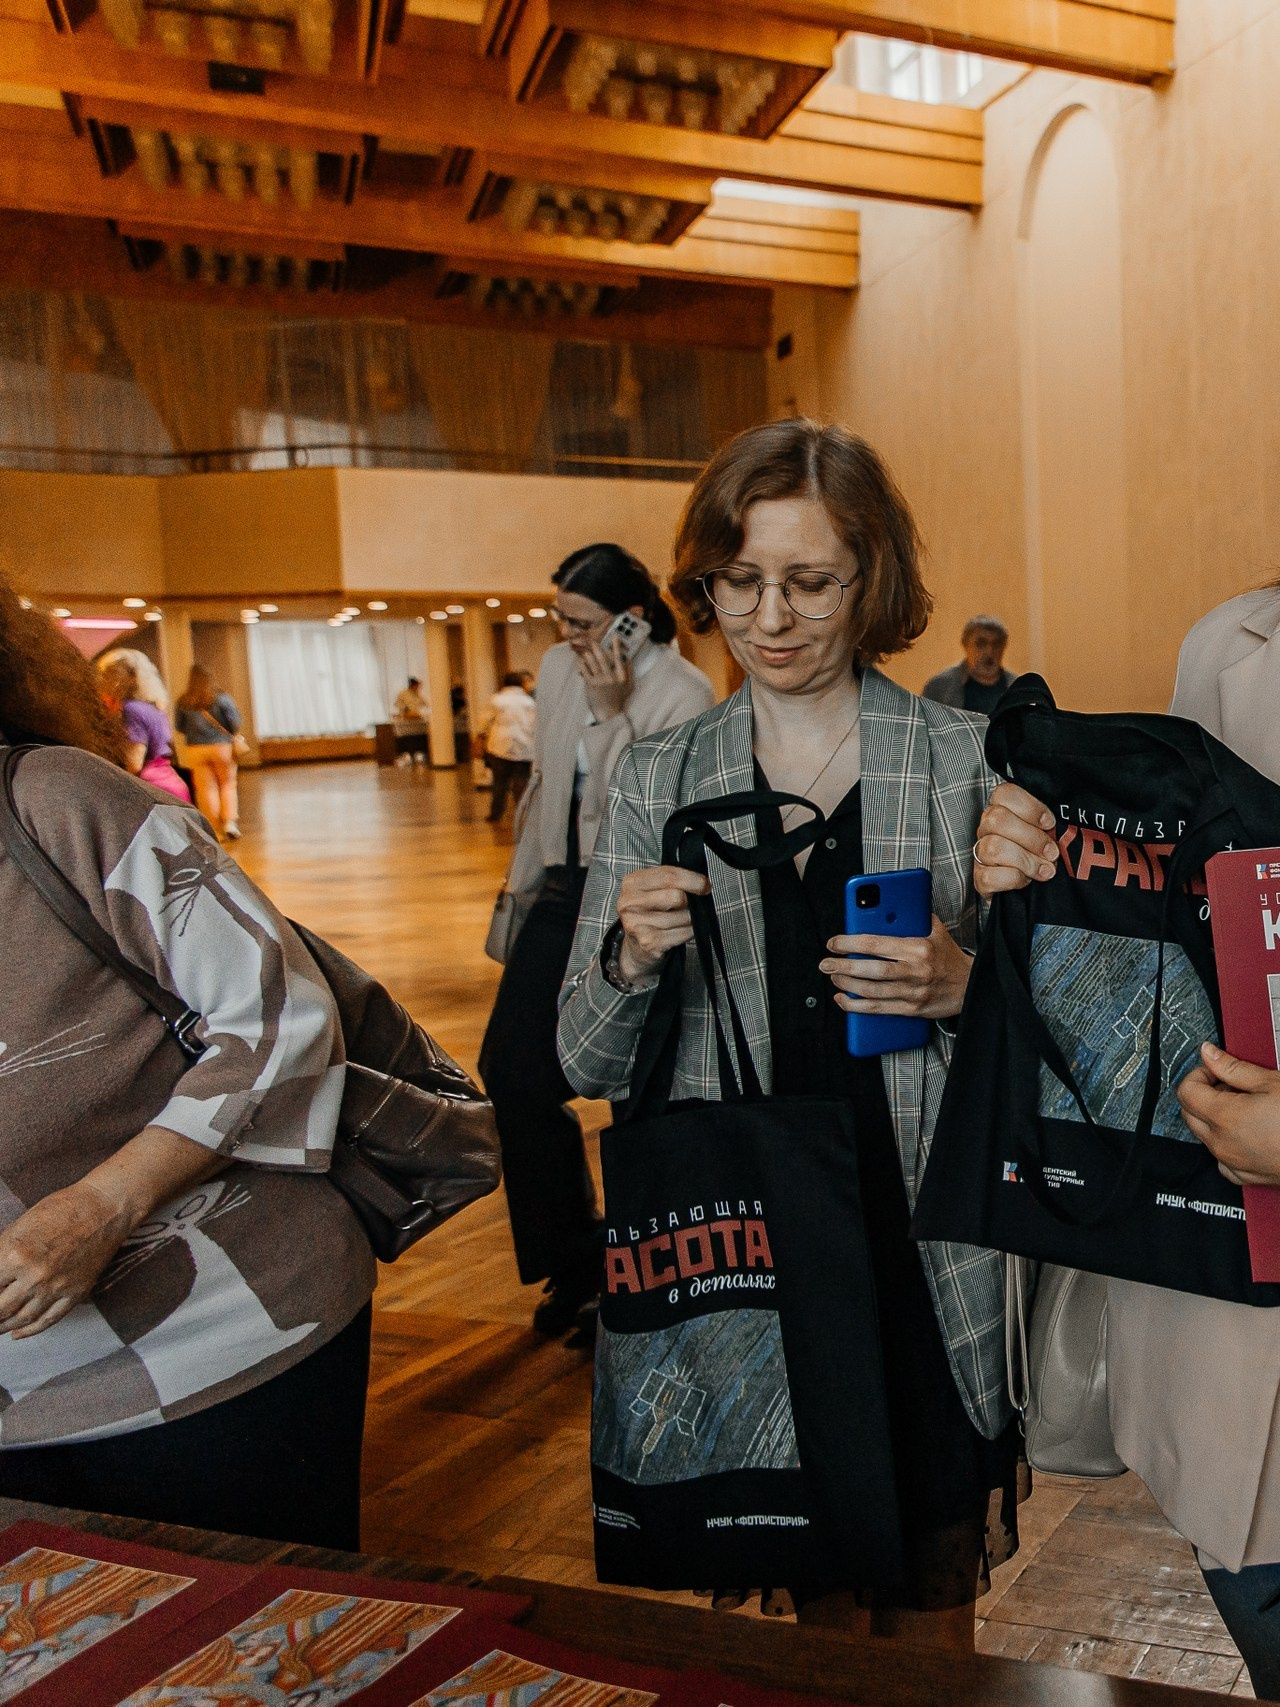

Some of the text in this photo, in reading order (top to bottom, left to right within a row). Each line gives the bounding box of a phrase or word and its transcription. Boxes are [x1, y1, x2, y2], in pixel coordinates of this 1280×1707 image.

[1043, 1167, 1077, 1177] ДЕНТСКИЙ
[1156, 1193, 1186, 1209] НЧУК
[603, 1219, 774, 1294] АСОТА
[668, 1273, 776, 1303] в деталях
[706, 1515, 810, 1528] НЧУК «ФОТОИСТОРИЯ»
